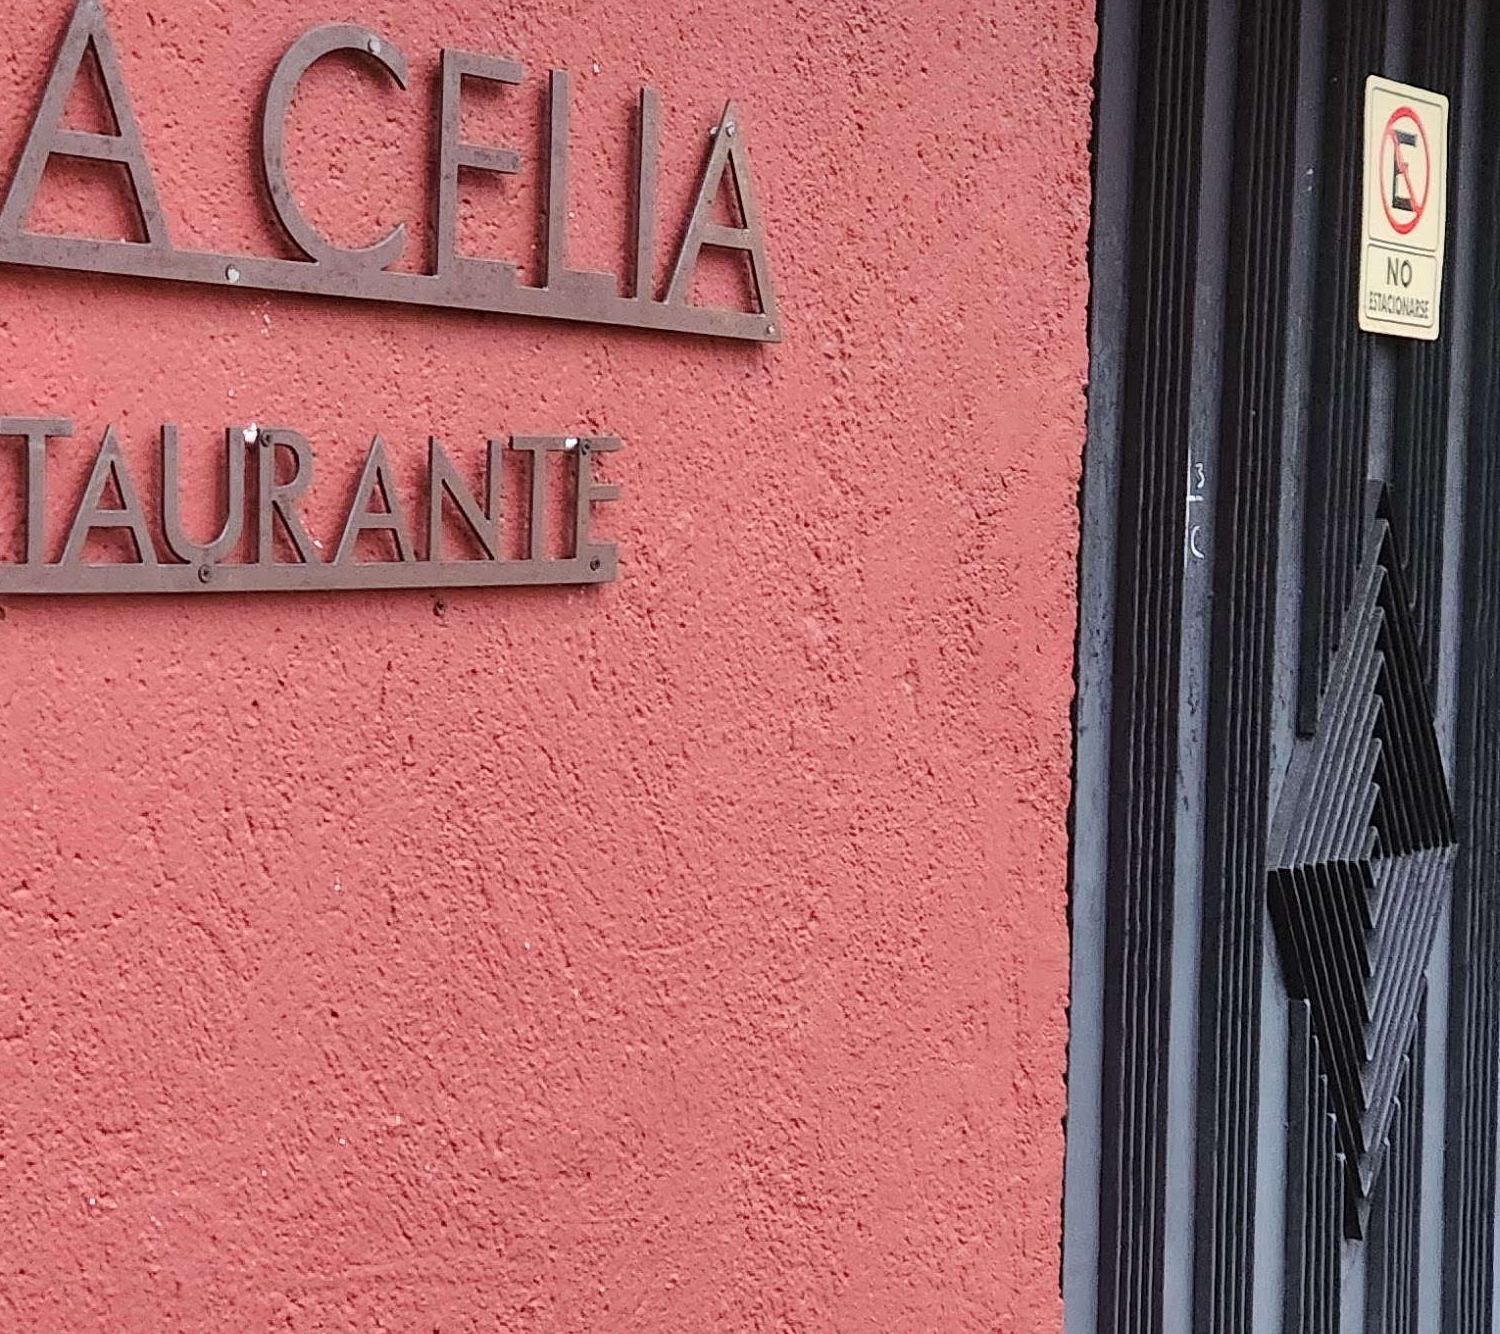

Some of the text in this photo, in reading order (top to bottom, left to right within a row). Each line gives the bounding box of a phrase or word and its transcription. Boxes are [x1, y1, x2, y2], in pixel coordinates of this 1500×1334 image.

[262, 22, 780, 342] CELIA
[1386, 256, 1413, 288] NO
[1368, 290, 1430, 319] ESTACIONARSE
